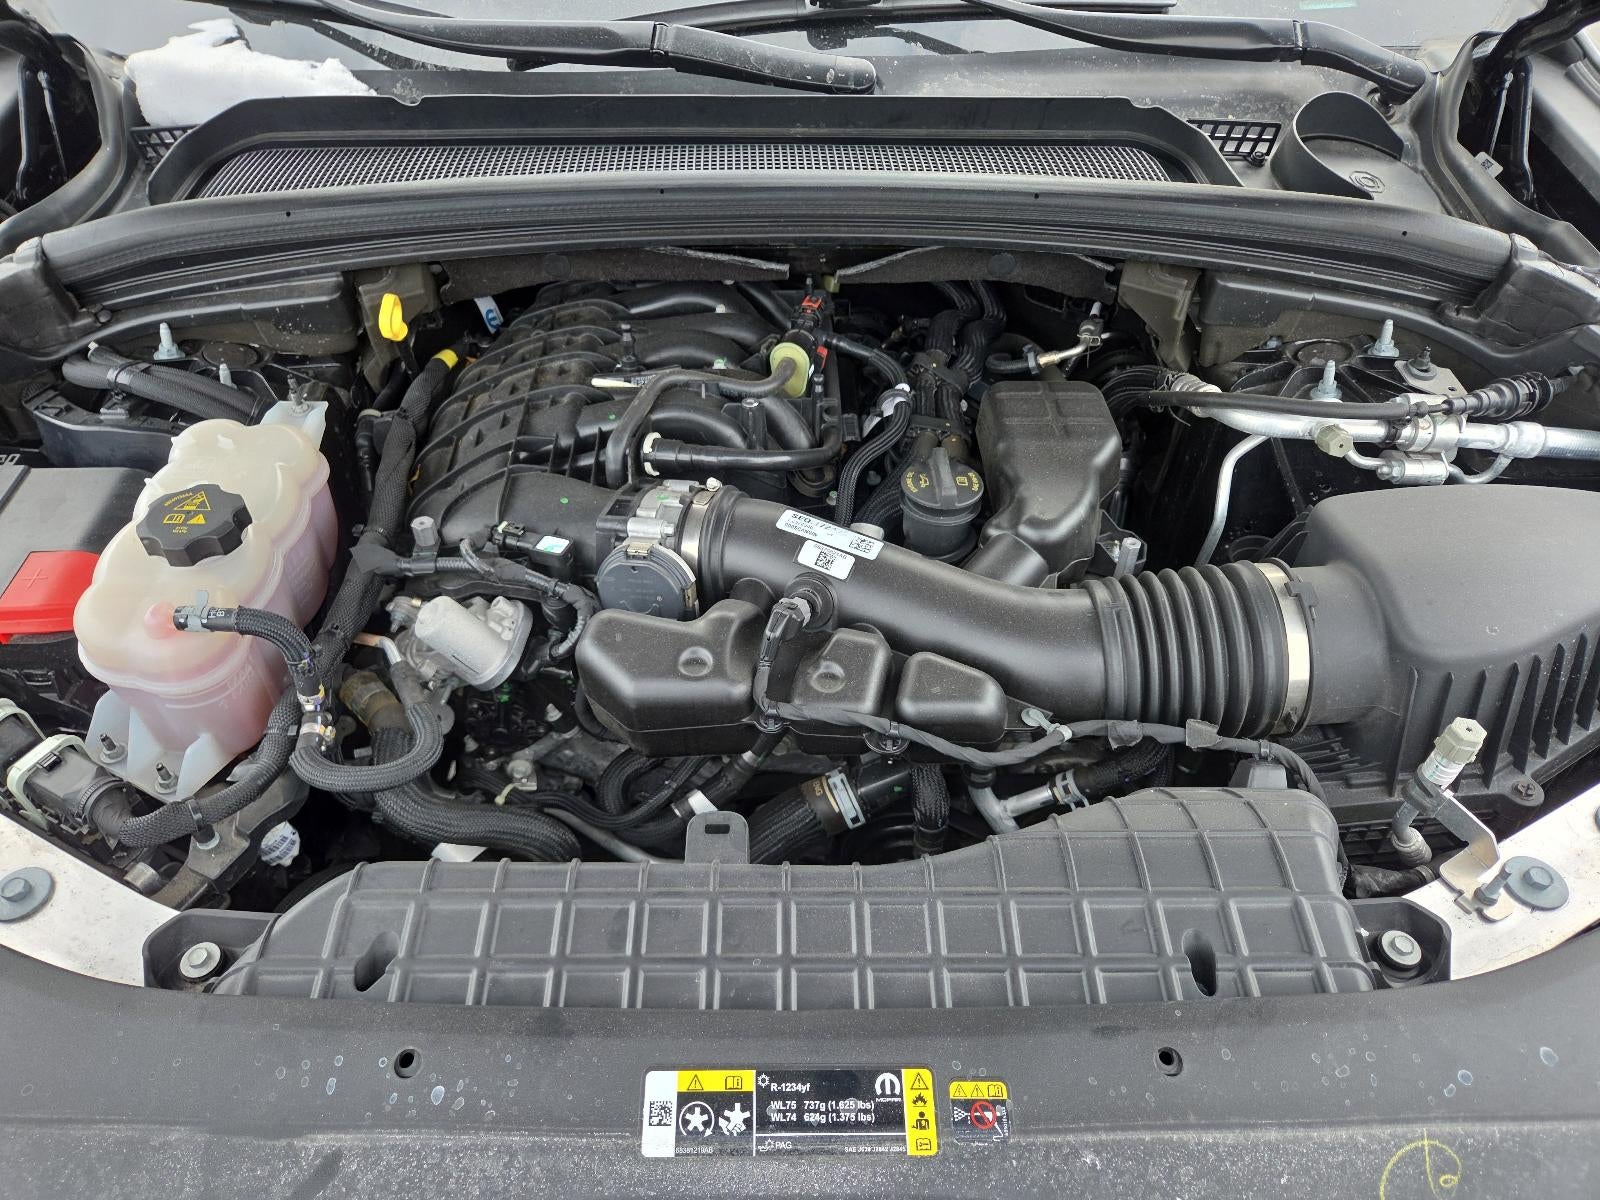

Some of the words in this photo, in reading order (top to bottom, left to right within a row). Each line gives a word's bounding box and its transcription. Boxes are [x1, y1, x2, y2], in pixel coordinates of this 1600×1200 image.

[770, 1083, 811, 1093] R-1234yf
[771, 1101, 797, 1110] WL75
[804, 1101, 826, 1111] 737g
[828, 1100, 856, 1111] (1.625
[857, 1100, 875, 1111] lbs)
[771, 1113, 797, 1121] WL74
[803, 1113, 826, 1123] 624g
[828, 1112, 856, 1123] (1.375
[857, 1112, 875, 1123] lbs)
